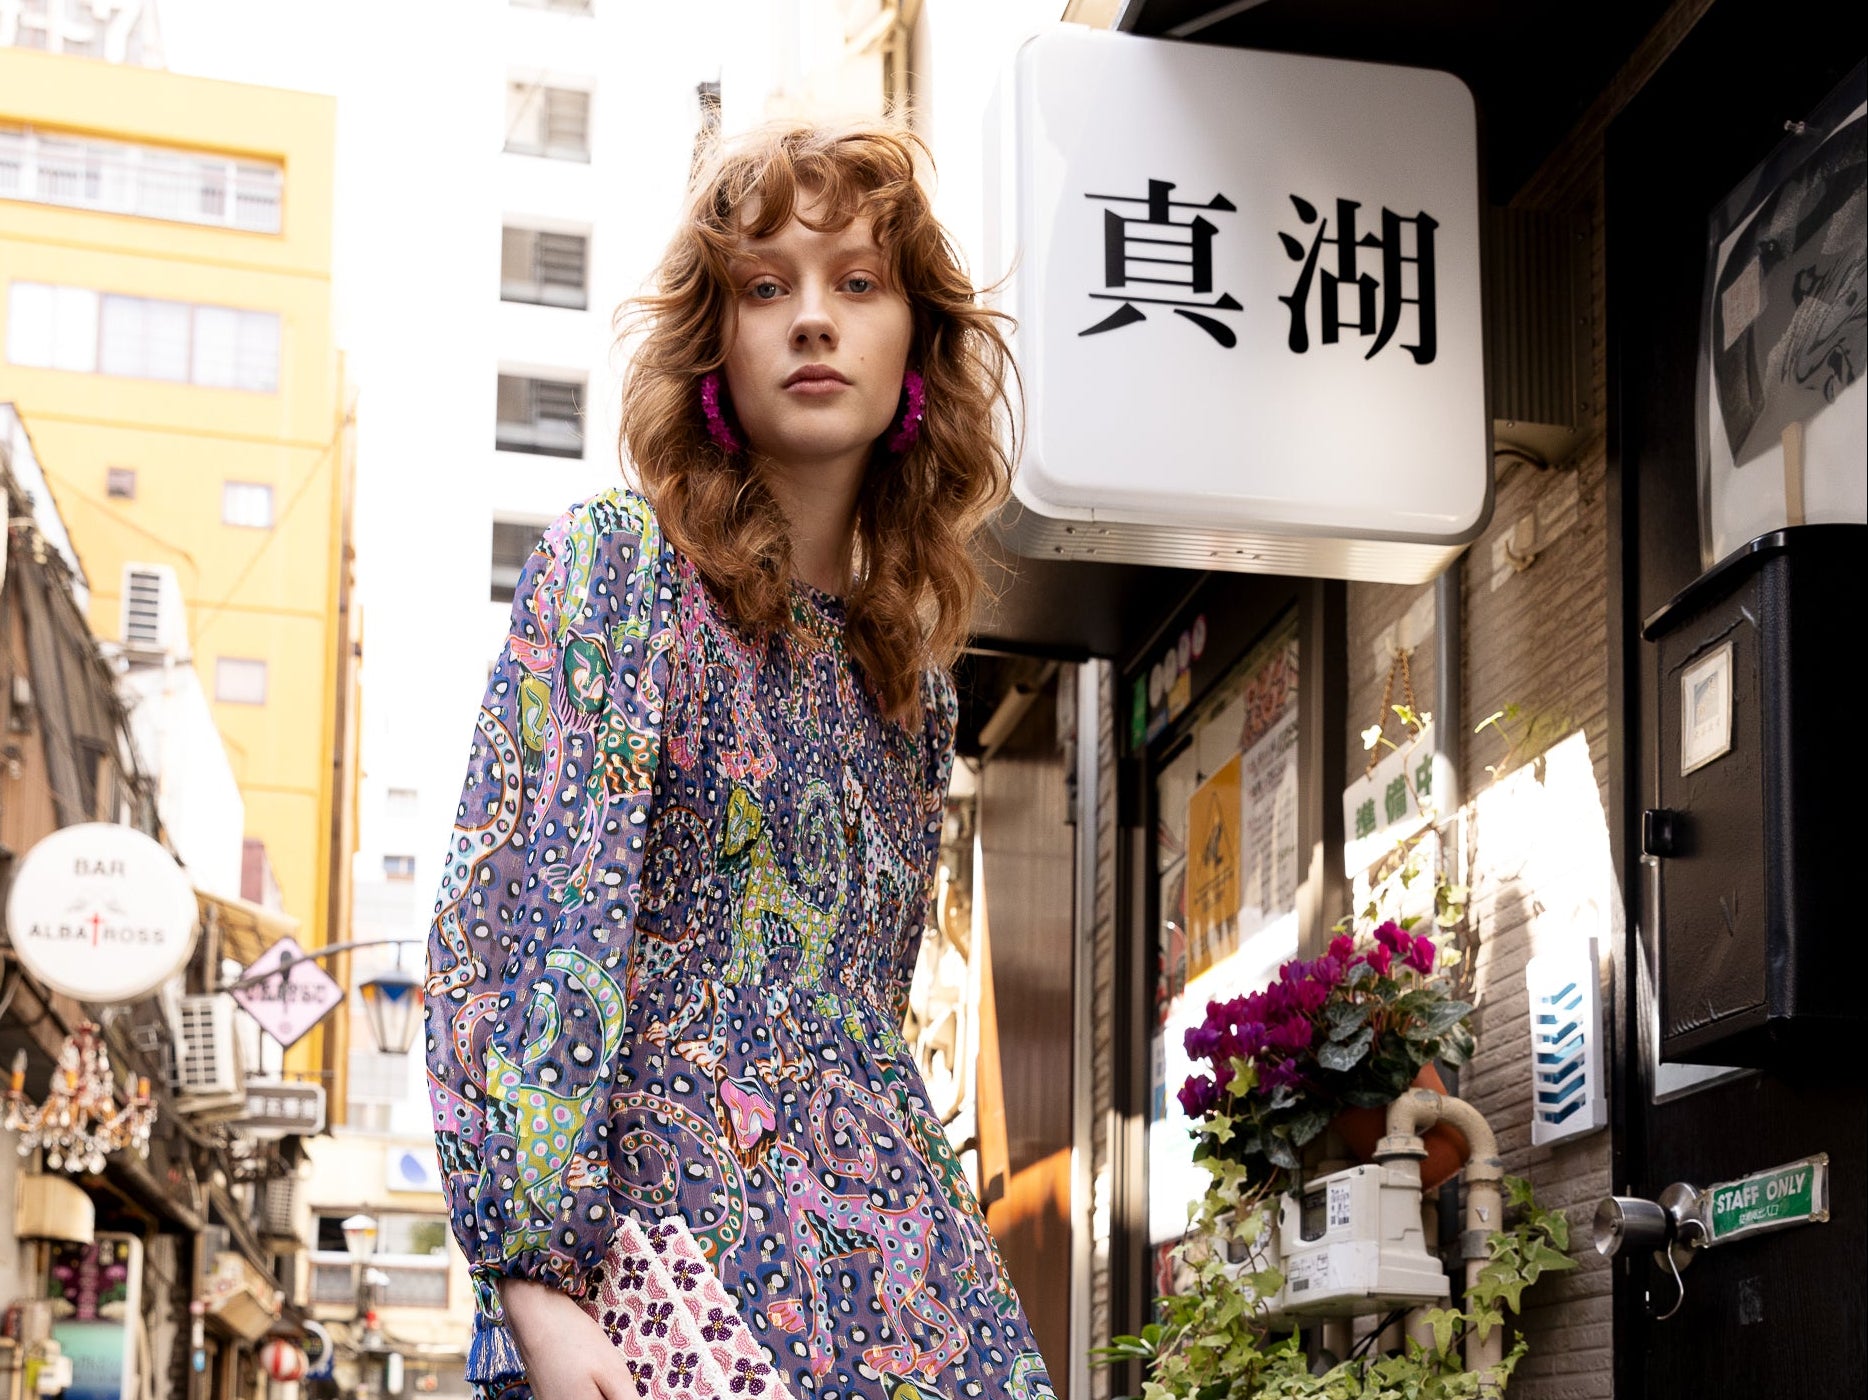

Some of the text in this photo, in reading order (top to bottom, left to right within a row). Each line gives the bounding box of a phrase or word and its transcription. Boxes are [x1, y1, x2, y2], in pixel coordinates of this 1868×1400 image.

[1078, 179, 1439, 365] 真湖
[1356, 752, 1433, 840] 準備中
[75, 858, 126, 877] BAR
[30, 913, 165, 946] ALBATROSS
[1716, 1185, 1759, 1214] STAFF
[1766, 1173, 1805, 1201] ONLY
